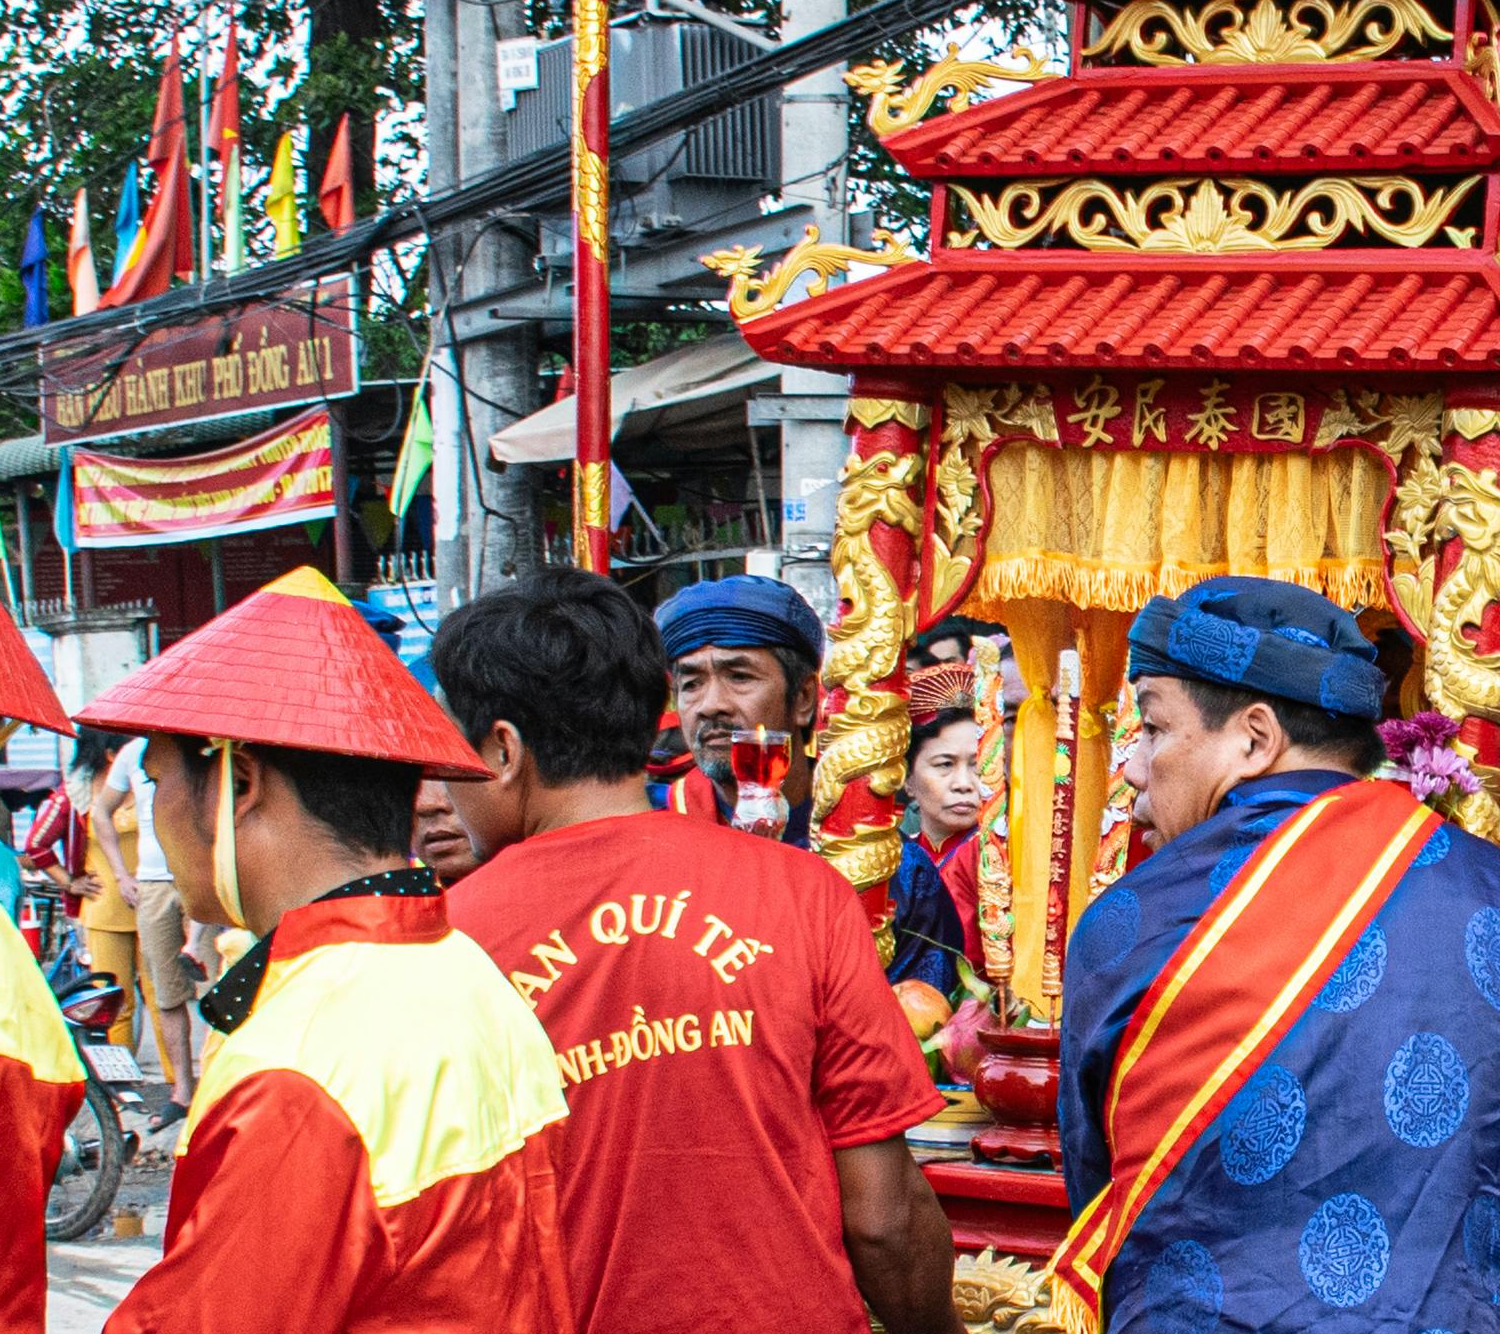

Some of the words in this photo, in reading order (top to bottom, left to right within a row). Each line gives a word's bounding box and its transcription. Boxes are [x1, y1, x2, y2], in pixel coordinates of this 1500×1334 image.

[123, 357, 171, 415] HÀNH
[173, 360, 207, 407] KHU
[212, 332, 243, 400] PHỐ
[248, 326, 289, 394] ĐỒNG
[297, 340, 320, 385] AN
[323, 336, 333, 380] 1
[510, 929, 578, 1011] AN
[589, 890, 692, 945] QUÍ
[692, 914, 774, 984] TẾ
[556, 1004, 702, 1089] NH-ĐỒNG
[710, 1009, 754, 1048] AN
